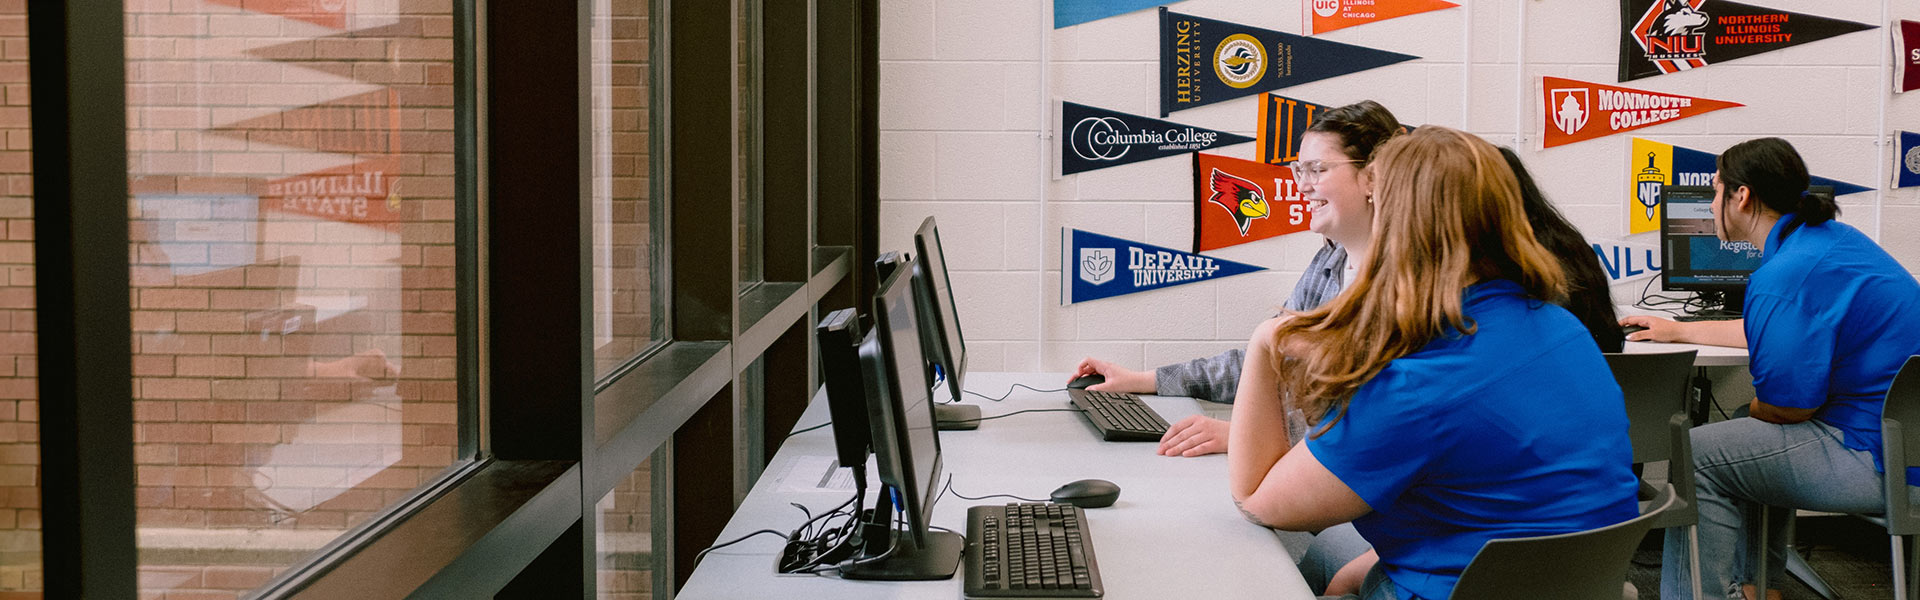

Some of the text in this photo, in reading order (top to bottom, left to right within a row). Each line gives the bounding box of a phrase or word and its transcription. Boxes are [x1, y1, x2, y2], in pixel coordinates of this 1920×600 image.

[1316, 0, 1337, 9] UIC
[1718, 14, 1789, 25] NORTHERN
[1715, 33, 1793, 45] UNIVERSITY
[1726, 24, 1781, 35] ILLINOIS
[1649, 35, 1702, 54] NIU
[1177, 20, 1191, 103] HERZING
[1193, 21, 1201, 102] UNIVERSITY
[1598, 89, 1692, 111] MONMOUTH
[1610, 108, 1680, 131] COLLEGE
[1094, 127, 1217, 146] Columbia College
[1158, 141, 1189, 150] established
[1134, 269, 1215, 288] UNIVERSITY
